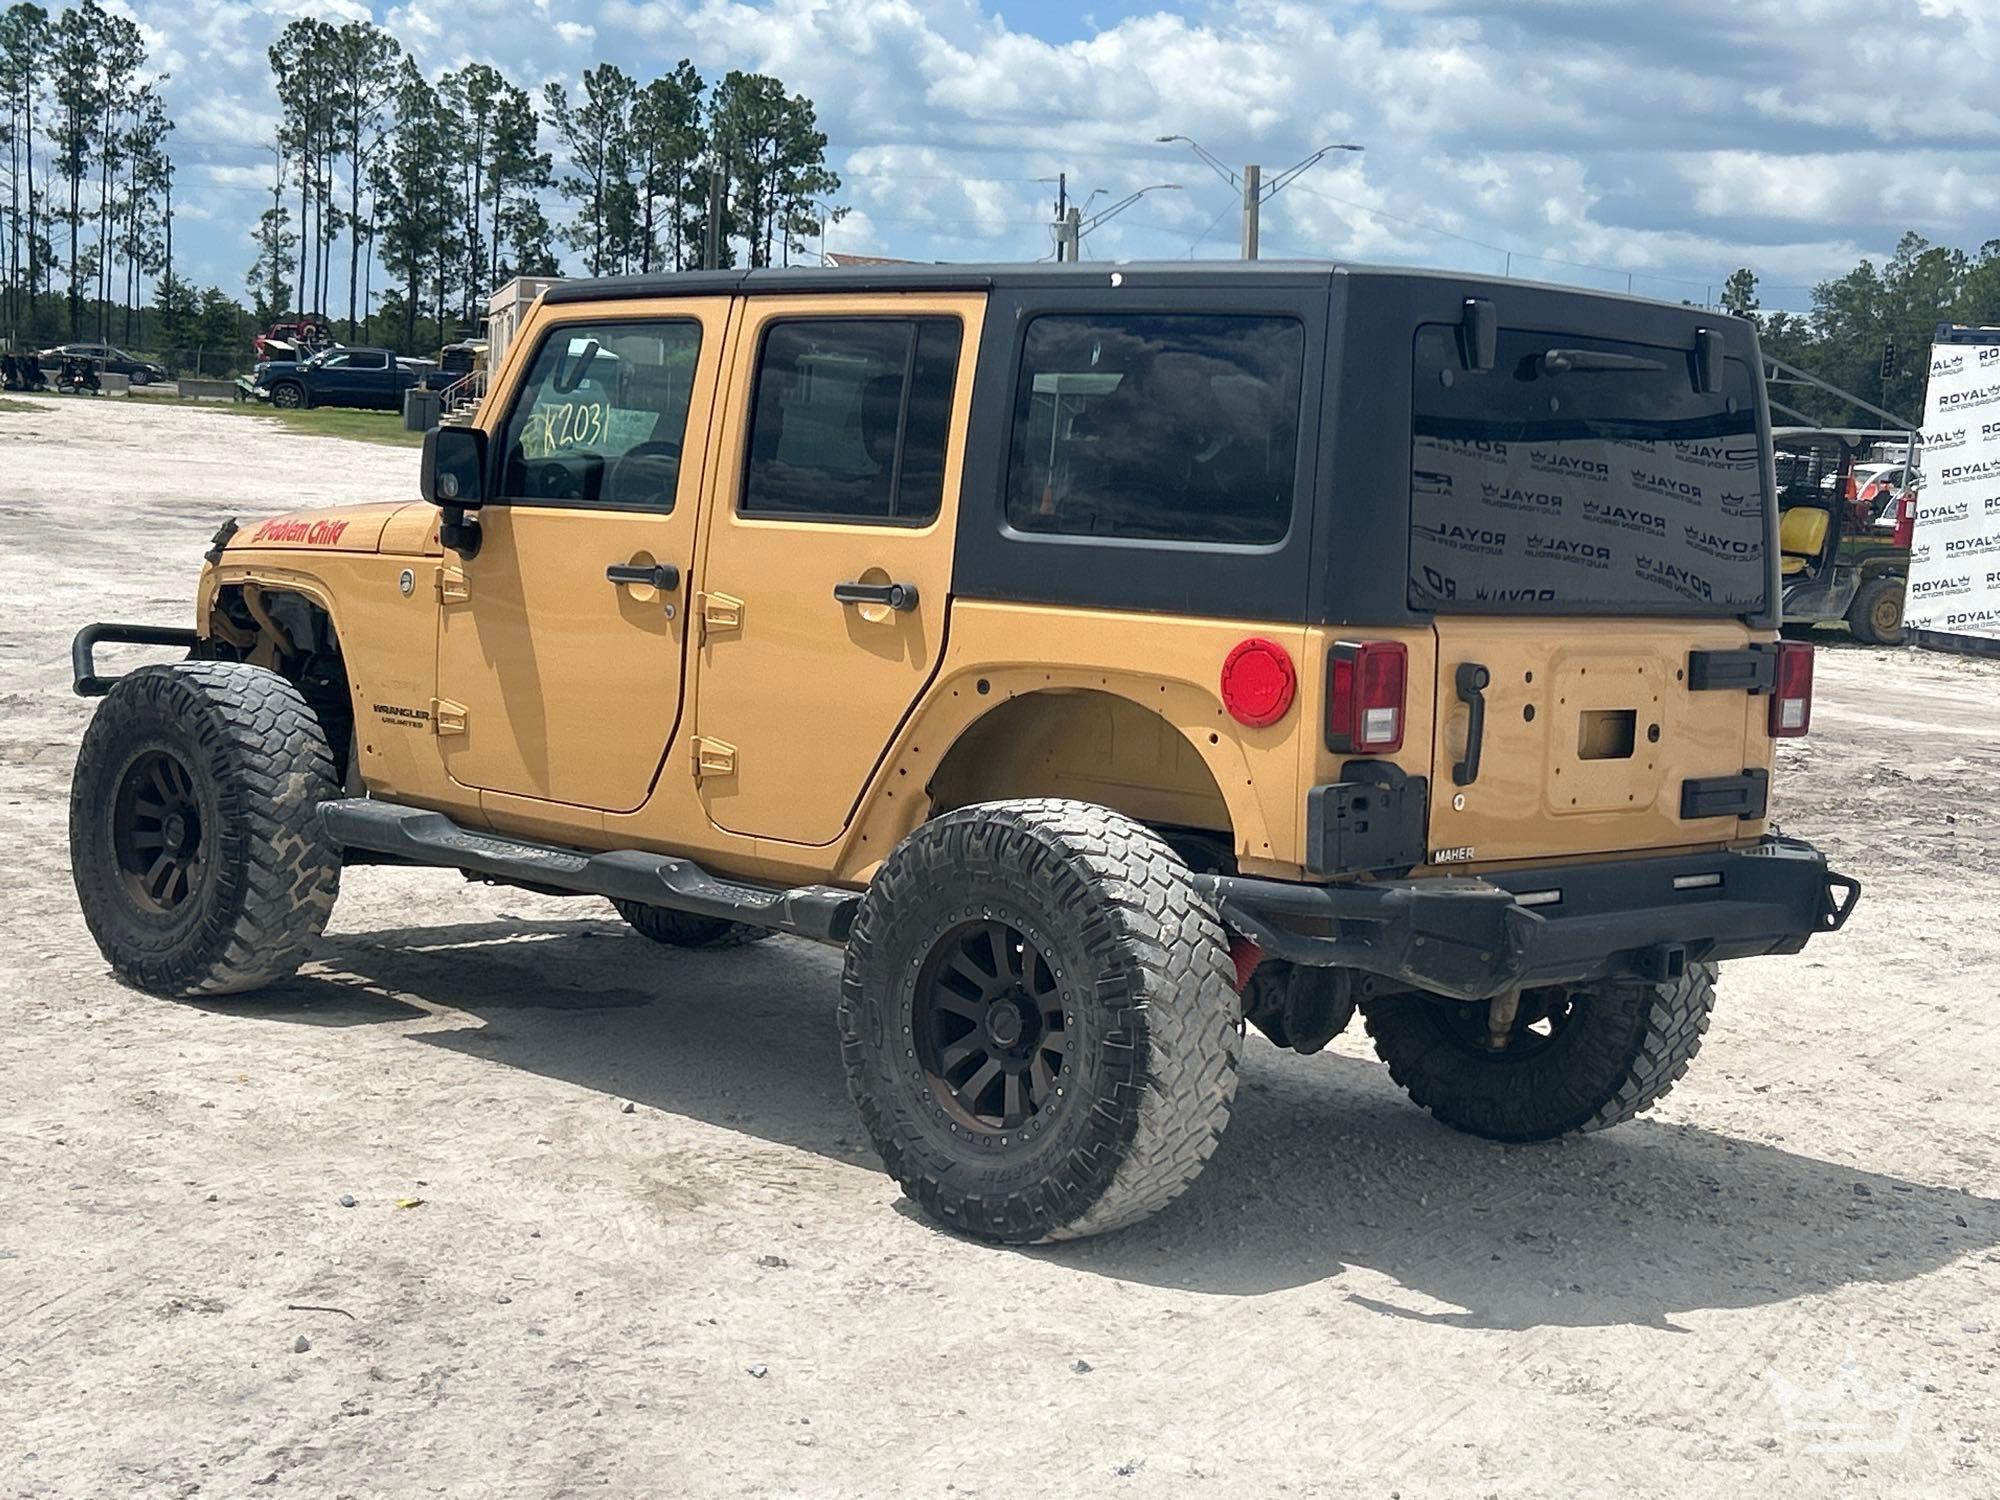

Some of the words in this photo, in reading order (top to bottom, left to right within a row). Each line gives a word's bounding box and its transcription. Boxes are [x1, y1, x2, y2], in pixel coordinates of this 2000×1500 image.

[1939, 388, 1988, 406] ROYAL
[1942, 462, 1991, 478] ROYAL
[307, 519, 350, 546] Child
[1945, 536, 1993, 551] ROYAL
[1912, 578, 1958, 593] ROYAL
[1947, 610, 1994, 625] ROYAL
[373, 704, 430, 721] WRANGLER
[1434, 847, 1475, 864] MAHER
